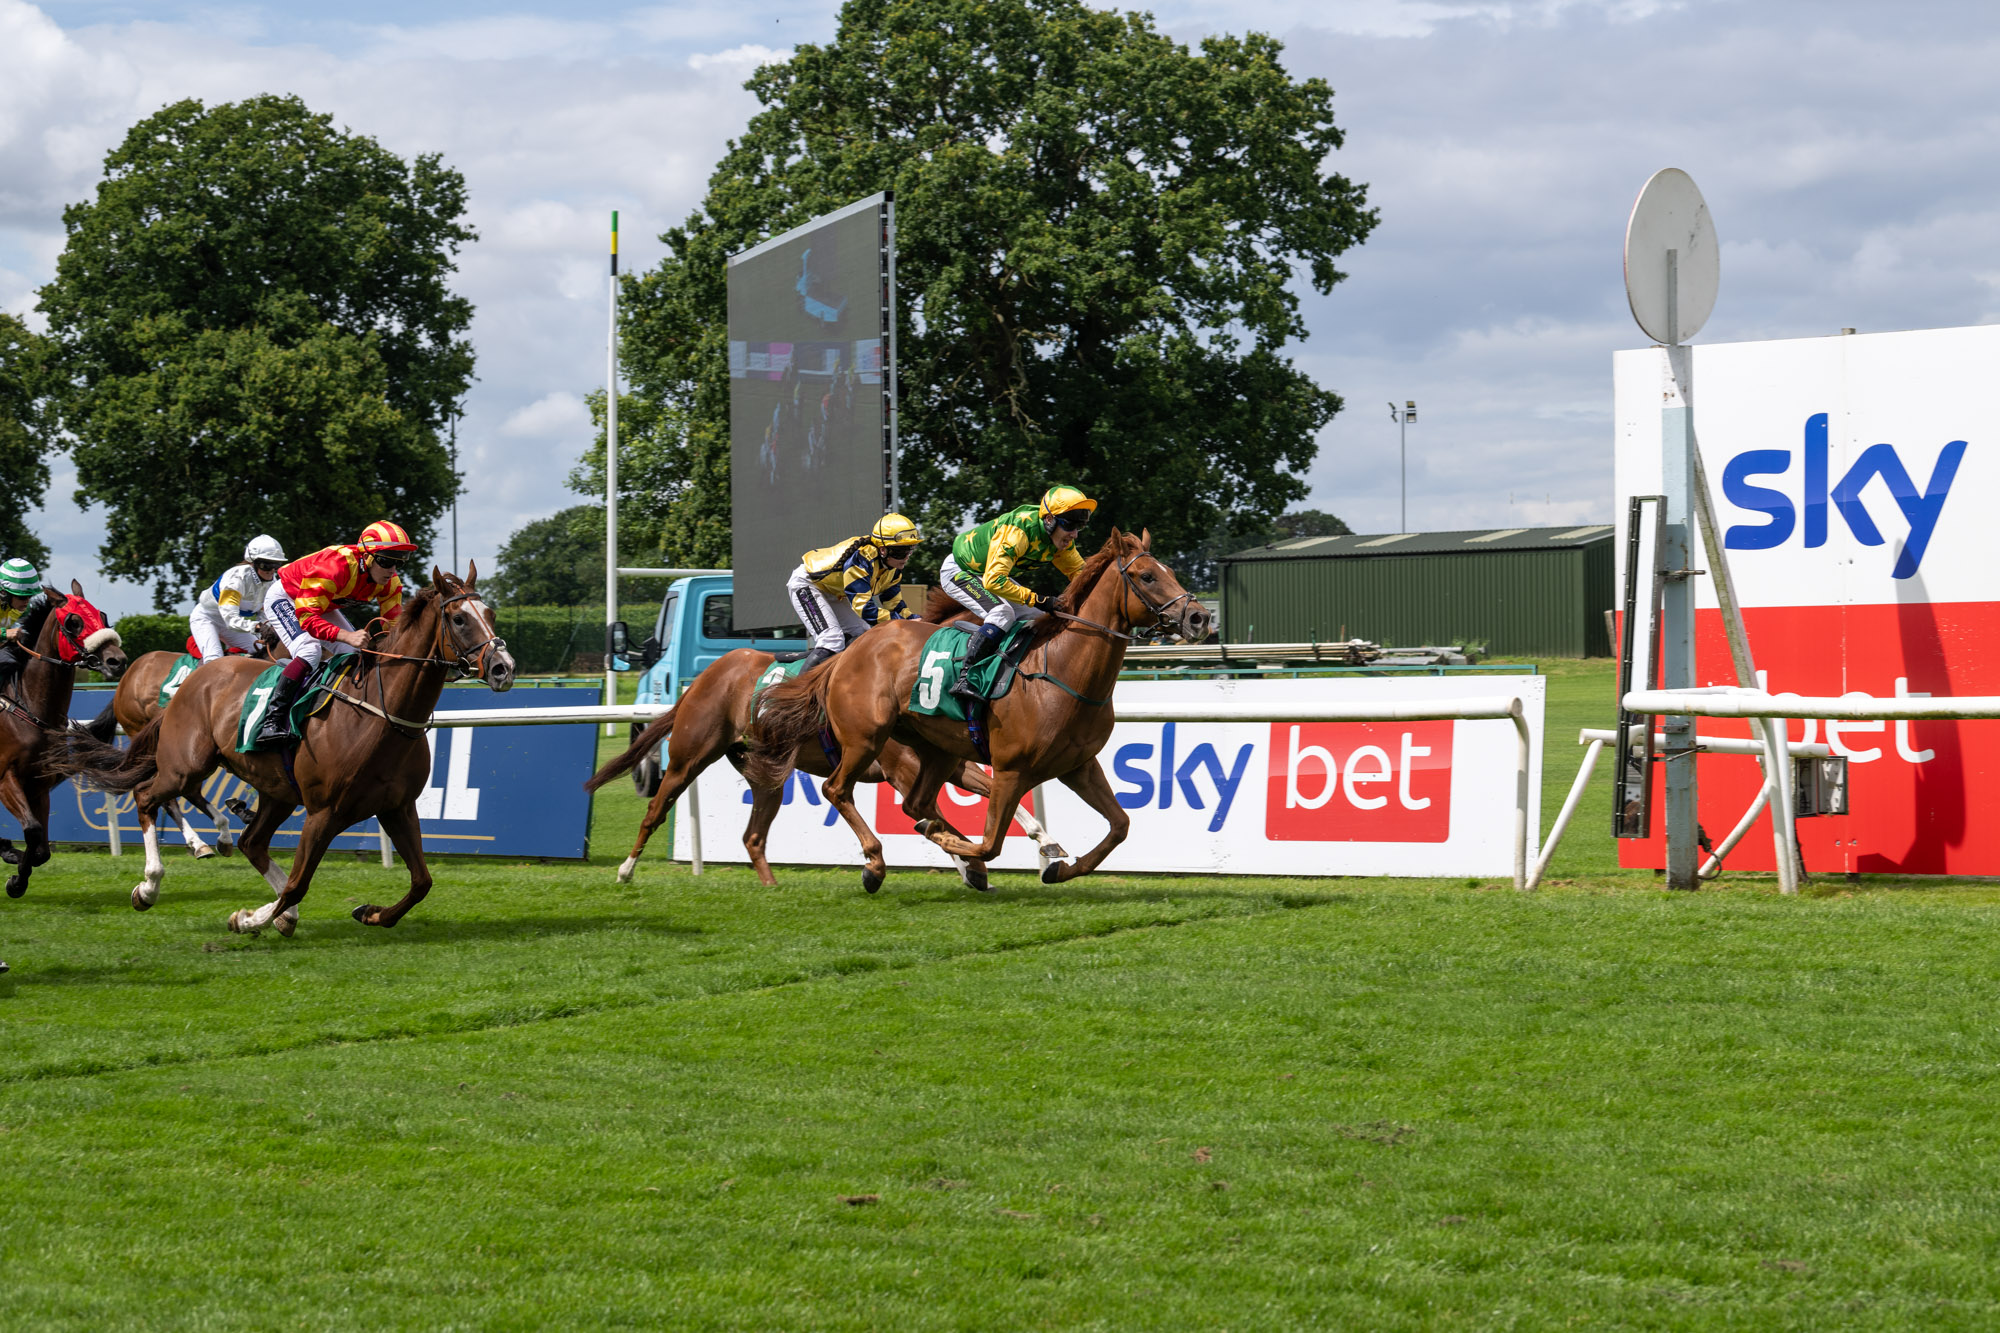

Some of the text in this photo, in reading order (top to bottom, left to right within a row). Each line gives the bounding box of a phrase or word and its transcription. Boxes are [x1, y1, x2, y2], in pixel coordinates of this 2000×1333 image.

[1722, 412, 1968, 580] sky
[965, 584, 982, 600] Racing
[243, 687, 273, 746] 7
[919, 650, 951, 709] 5
[1755, 670, 1936, 764] et
[1113, 721, 1254, 833] sky
[1286, 725, 1431, 811] bet
